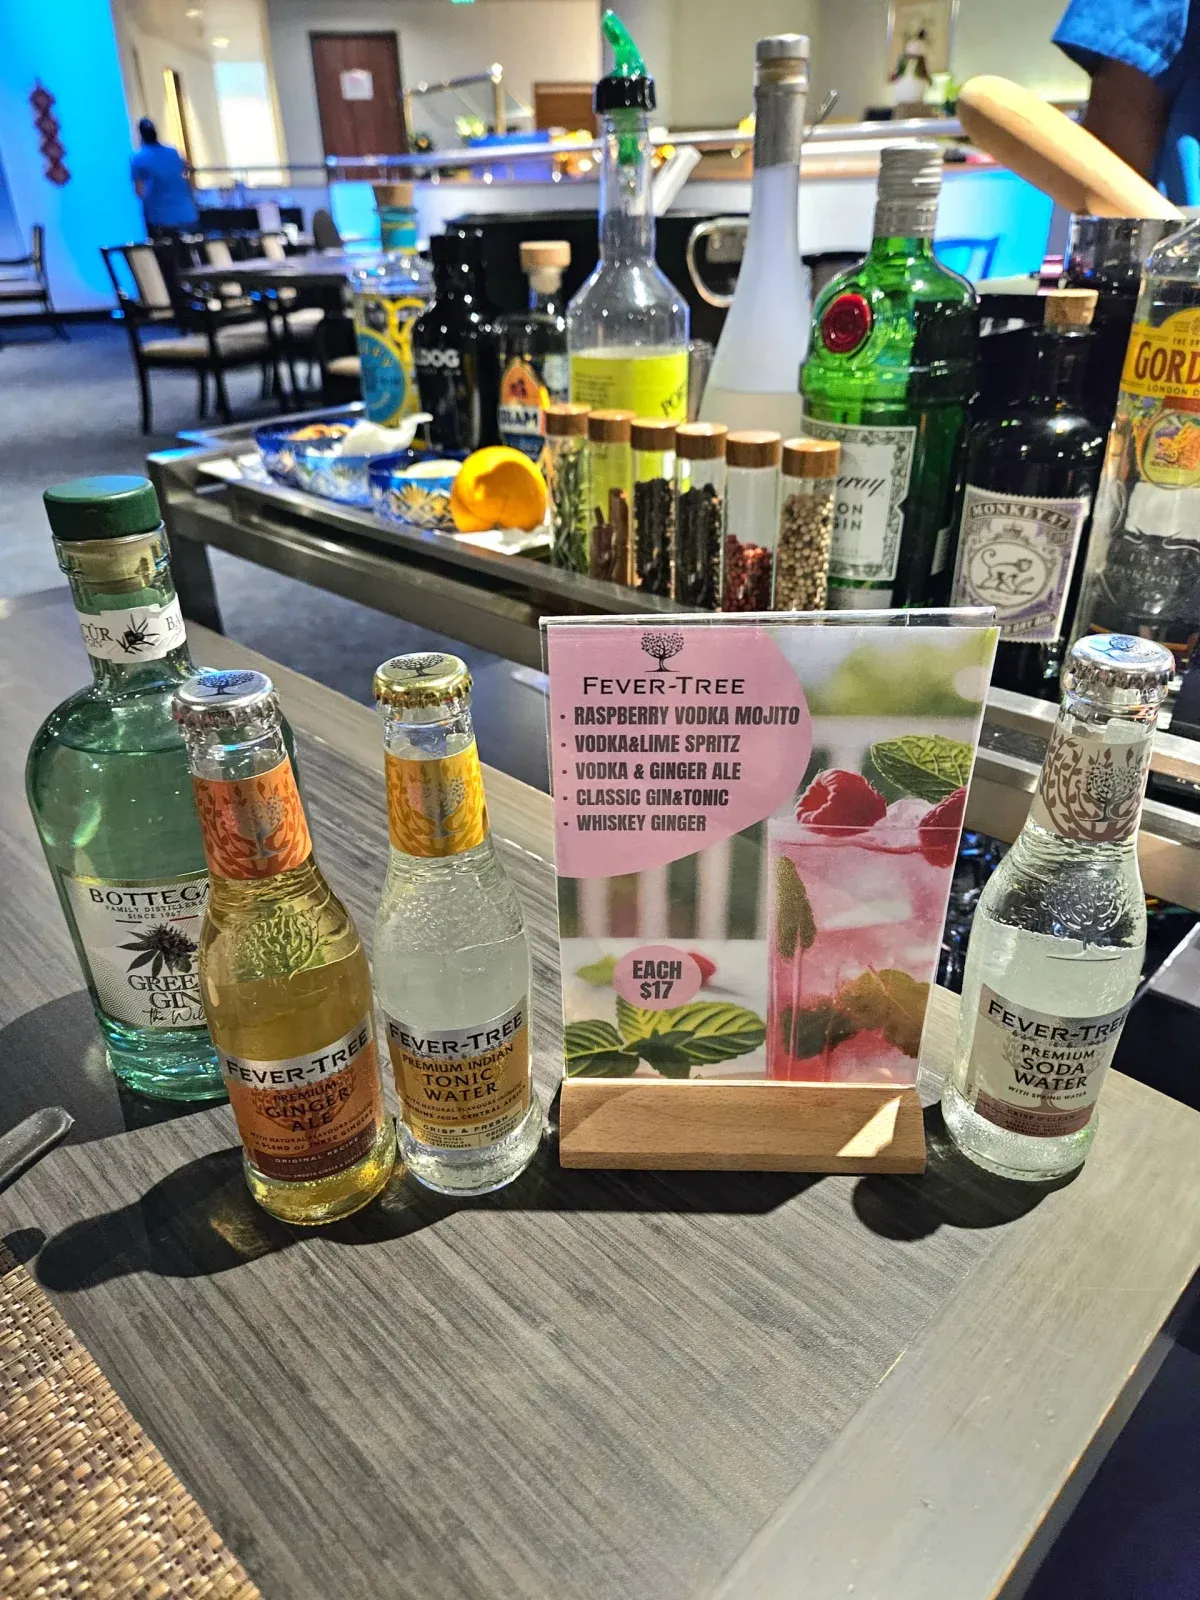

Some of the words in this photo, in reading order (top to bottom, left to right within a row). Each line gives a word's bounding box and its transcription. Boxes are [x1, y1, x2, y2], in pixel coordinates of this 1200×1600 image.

[1147, 384, 1188, 396] LONDON
[971, 504, 1047, 520] MONKEY
[583, 676, 746, 695] FEVER-TREE
[574, 706, 669, 726] RASPBERRY
[675, 706, 729, 726] VODKA
[735, 706, 800, 725] MOJITO
[575, 734, 680, 753] VODKA&LIME
[685, 734, 741, 753] SPRITZ
[575, 761, 628, 780] VODKA
[633, 762, 645, 780] &
[650, 761, 708, 780] GINGER
[711, 761, 742, 780] ALE
[576, 788, 641, 806] CLASSIC
[646, 788, 729, 806] GIN&TONIC
[576, 814, 646, 832] WHISKEY
[651, 814, 707, 832] GINGER
[632, 960, 682, 980] EACH
[128, 973, 200, 992] GREE
[639, 981, 674, 1000] $17
[388, 1011, 523, 1054] FEVER-TREE
[225, 1029, 368, 1084] FEVER-TREE
[402, 1054, 463, 1073] PREMIUM
[468, 1044, 513, 1071] INDIAN
[1021, 1043, 1095, 1062] PREMIUM
[1021, 1057, 1085, 1076] SODA
[422, 1068, 494, 1088] TONIC
[1014, 1068, 1088, 1091] WATER
[273, 1080, 338, 1104] PREMIUM
[423, 1081, 499, 1103] WATER
[1008, 1085, 1029, 1097] WITH
[1031, 1092, 1062, 1101] SPRING
[1064, 1091, 1087, 1100] WATER
[265, 1087, 351, 1119] GINGER
[421, 1103, 455, 1113] NATURAL
[461, 1105, 501, 1120] CENTRAL
[291, 1112, 334, 1132] ALE
[1007, 1108, 1035, 1120] CRISP
[308, 1121, 348, 1140] FLAVOURS
[423, 1124, 456, 1134] CRISP
[474, 1115, 508, 1132] FRESH
[260, 1142, 290, 1151] BLEND
[308, 1135, 338, 1148] THREE
[275, 1155, 324, 1164] ORIGINAL
[327, 1137, 359, 1156] RECIPE
